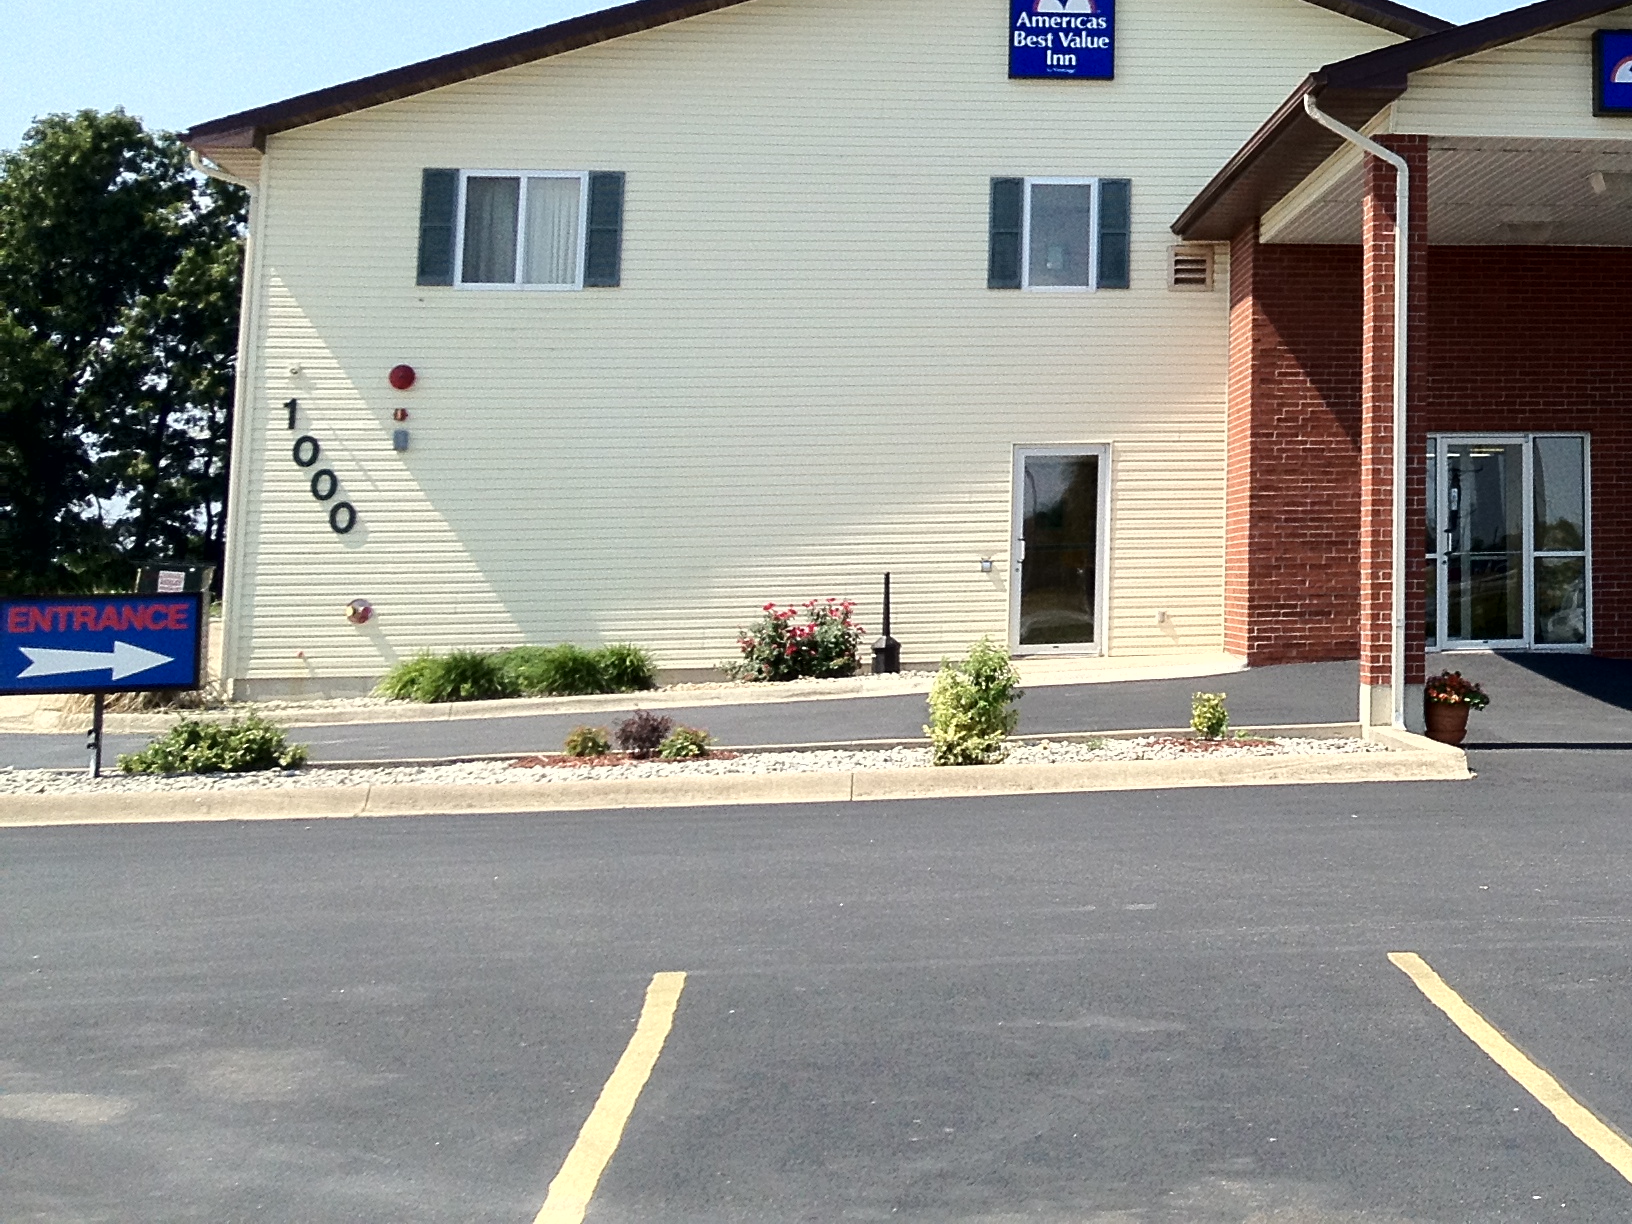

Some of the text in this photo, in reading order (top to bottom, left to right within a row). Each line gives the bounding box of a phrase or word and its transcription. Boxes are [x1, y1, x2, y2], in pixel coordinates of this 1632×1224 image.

[1016, 11, 1107, 28] Americas
[1013, 30, 1110, 48] Best Value
[1046, 49, 1076, 66] Inn
[283, 397, 357, 534] 1000
[7, 603, 190, 633] ENTRANCE
